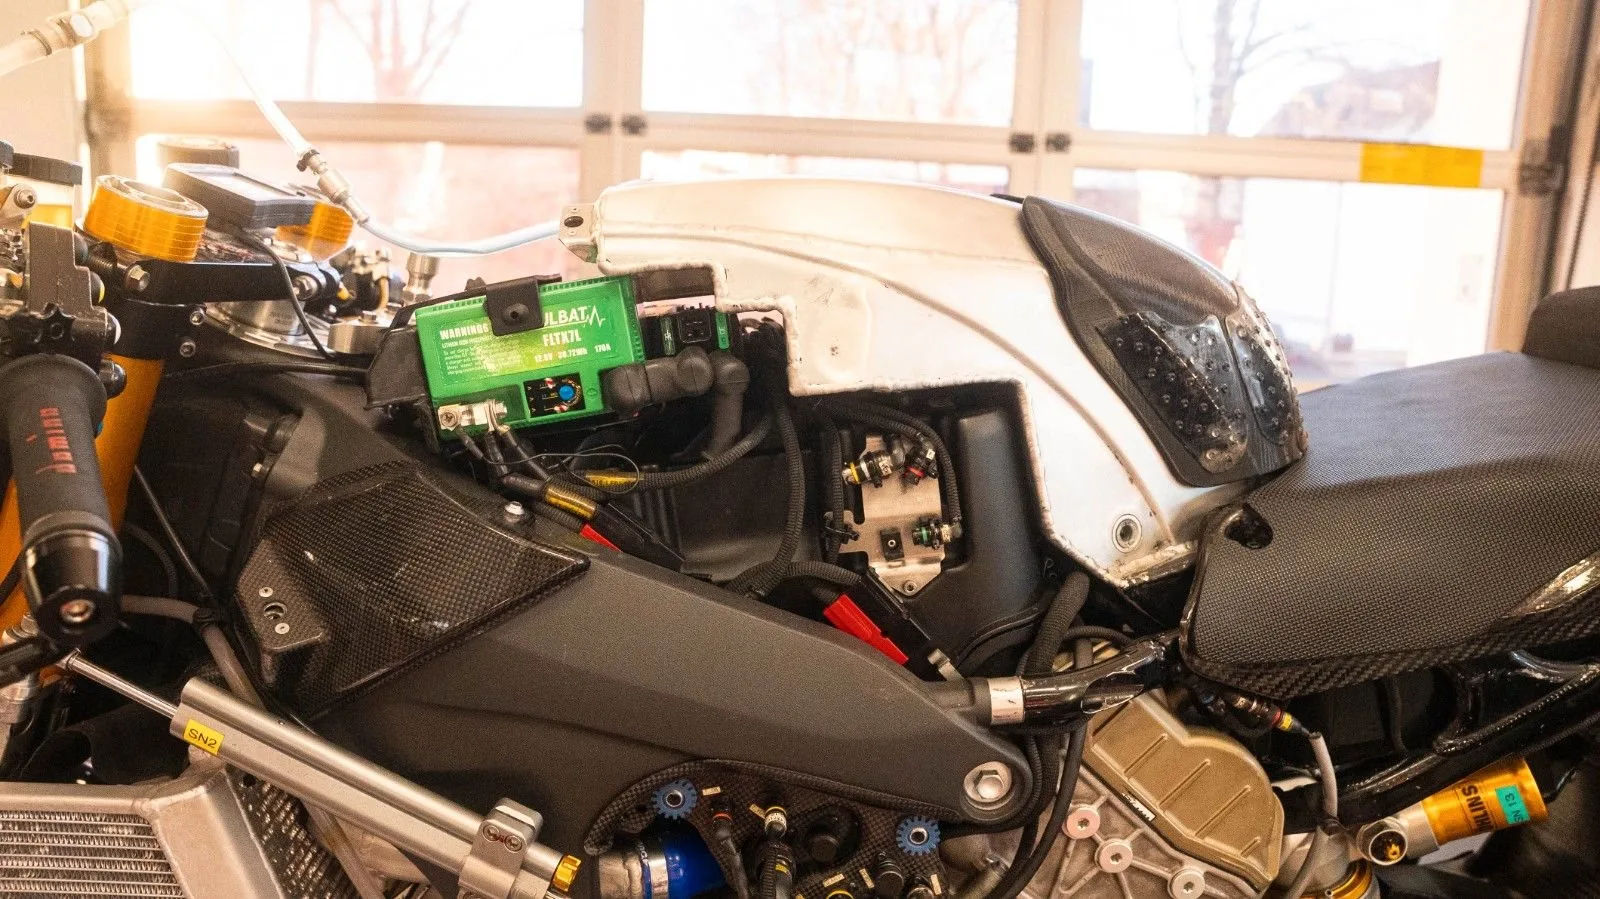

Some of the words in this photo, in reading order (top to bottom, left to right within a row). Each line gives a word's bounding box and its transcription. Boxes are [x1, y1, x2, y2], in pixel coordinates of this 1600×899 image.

[440, 323, 489, 340] WARNINGS
[188, 728, 217, 749] SN2
[1461, 784, 1495, 832] HLINS
[1504, 792, 1518, 807] 13
